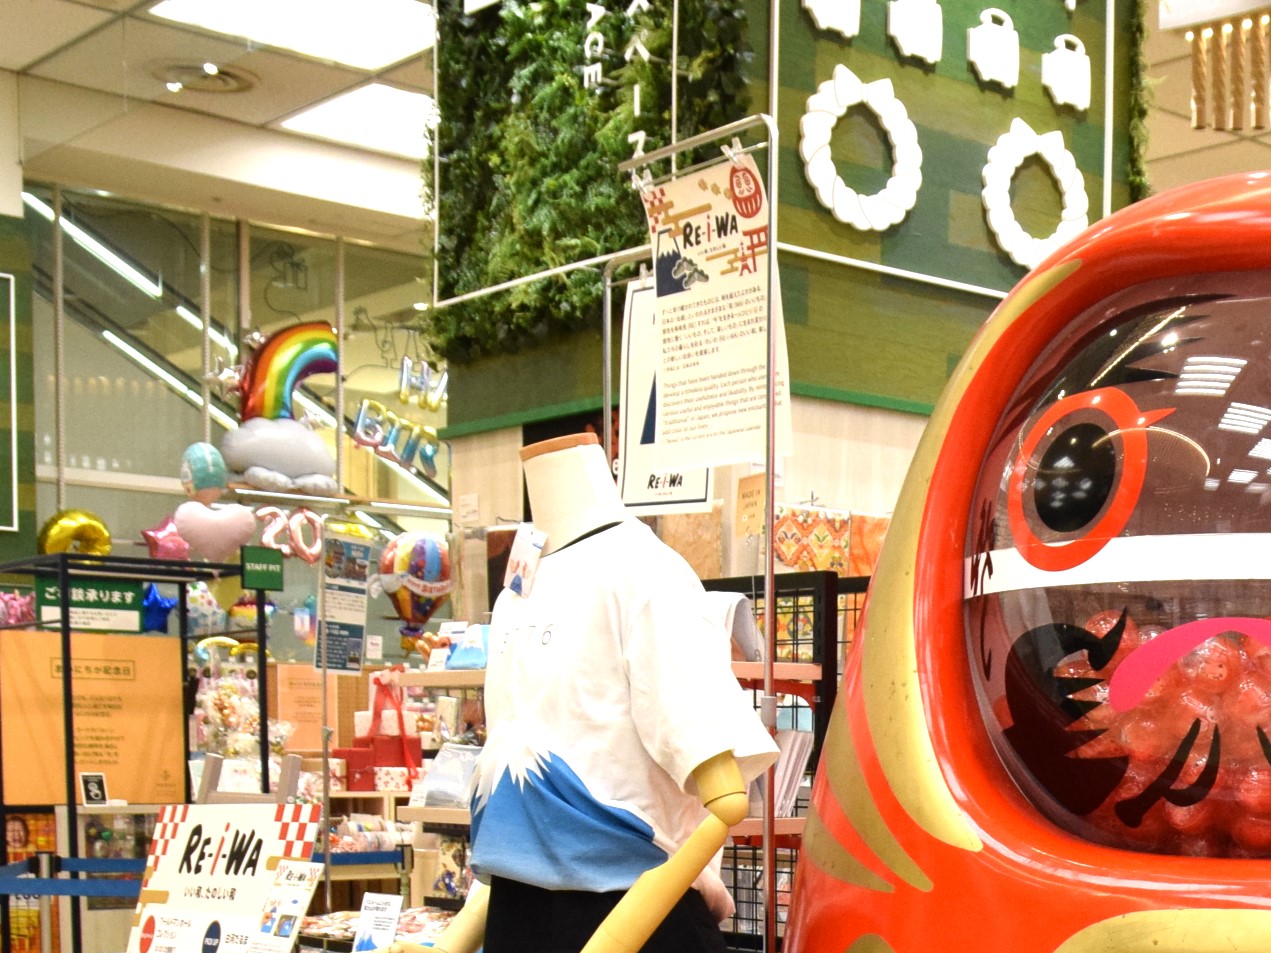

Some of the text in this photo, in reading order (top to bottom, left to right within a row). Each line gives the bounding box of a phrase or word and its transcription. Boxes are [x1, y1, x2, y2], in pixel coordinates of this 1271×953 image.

[44, 586, 135, 604] ご談承ります
